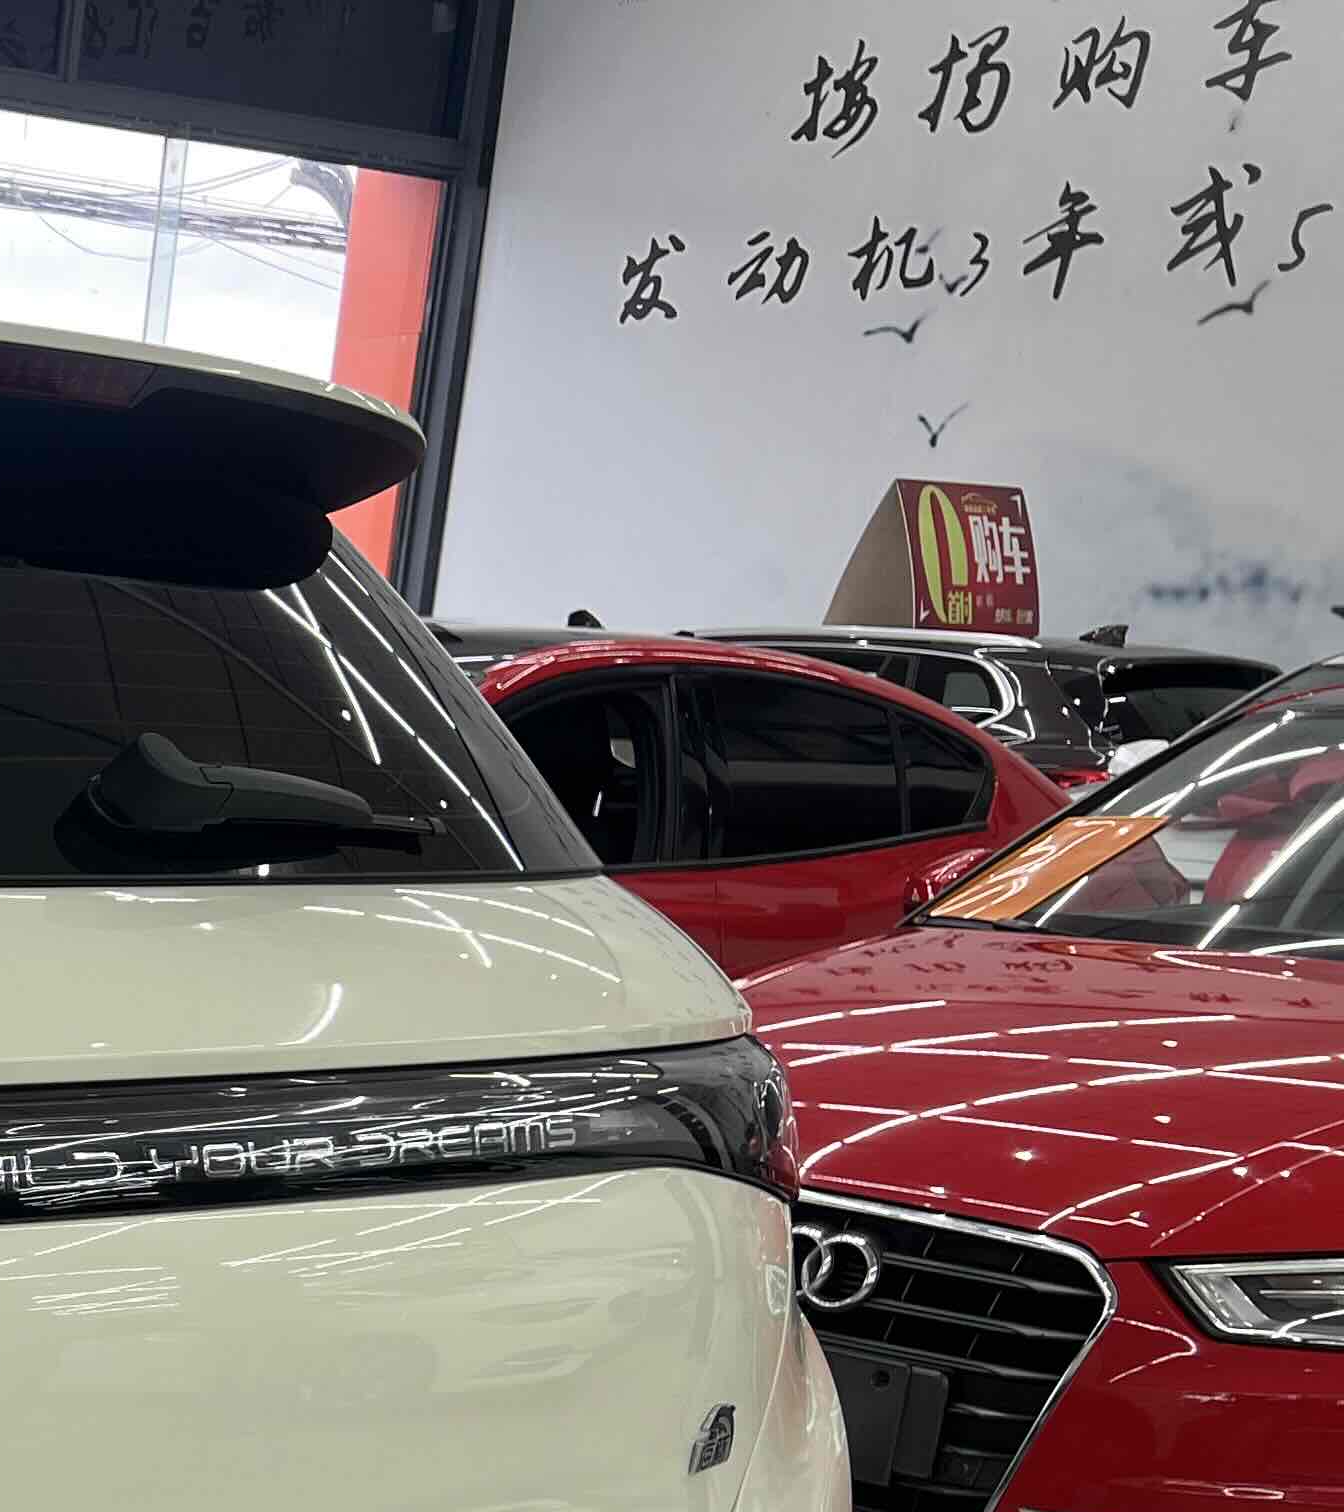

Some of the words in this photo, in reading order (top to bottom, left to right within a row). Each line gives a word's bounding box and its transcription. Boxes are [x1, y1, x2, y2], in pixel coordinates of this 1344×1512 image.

[968, 514, 1031, 585] 购车
[146, 1134, 335, 1183] YOUR
[350, 1114, 577, 1168] DREAMS
